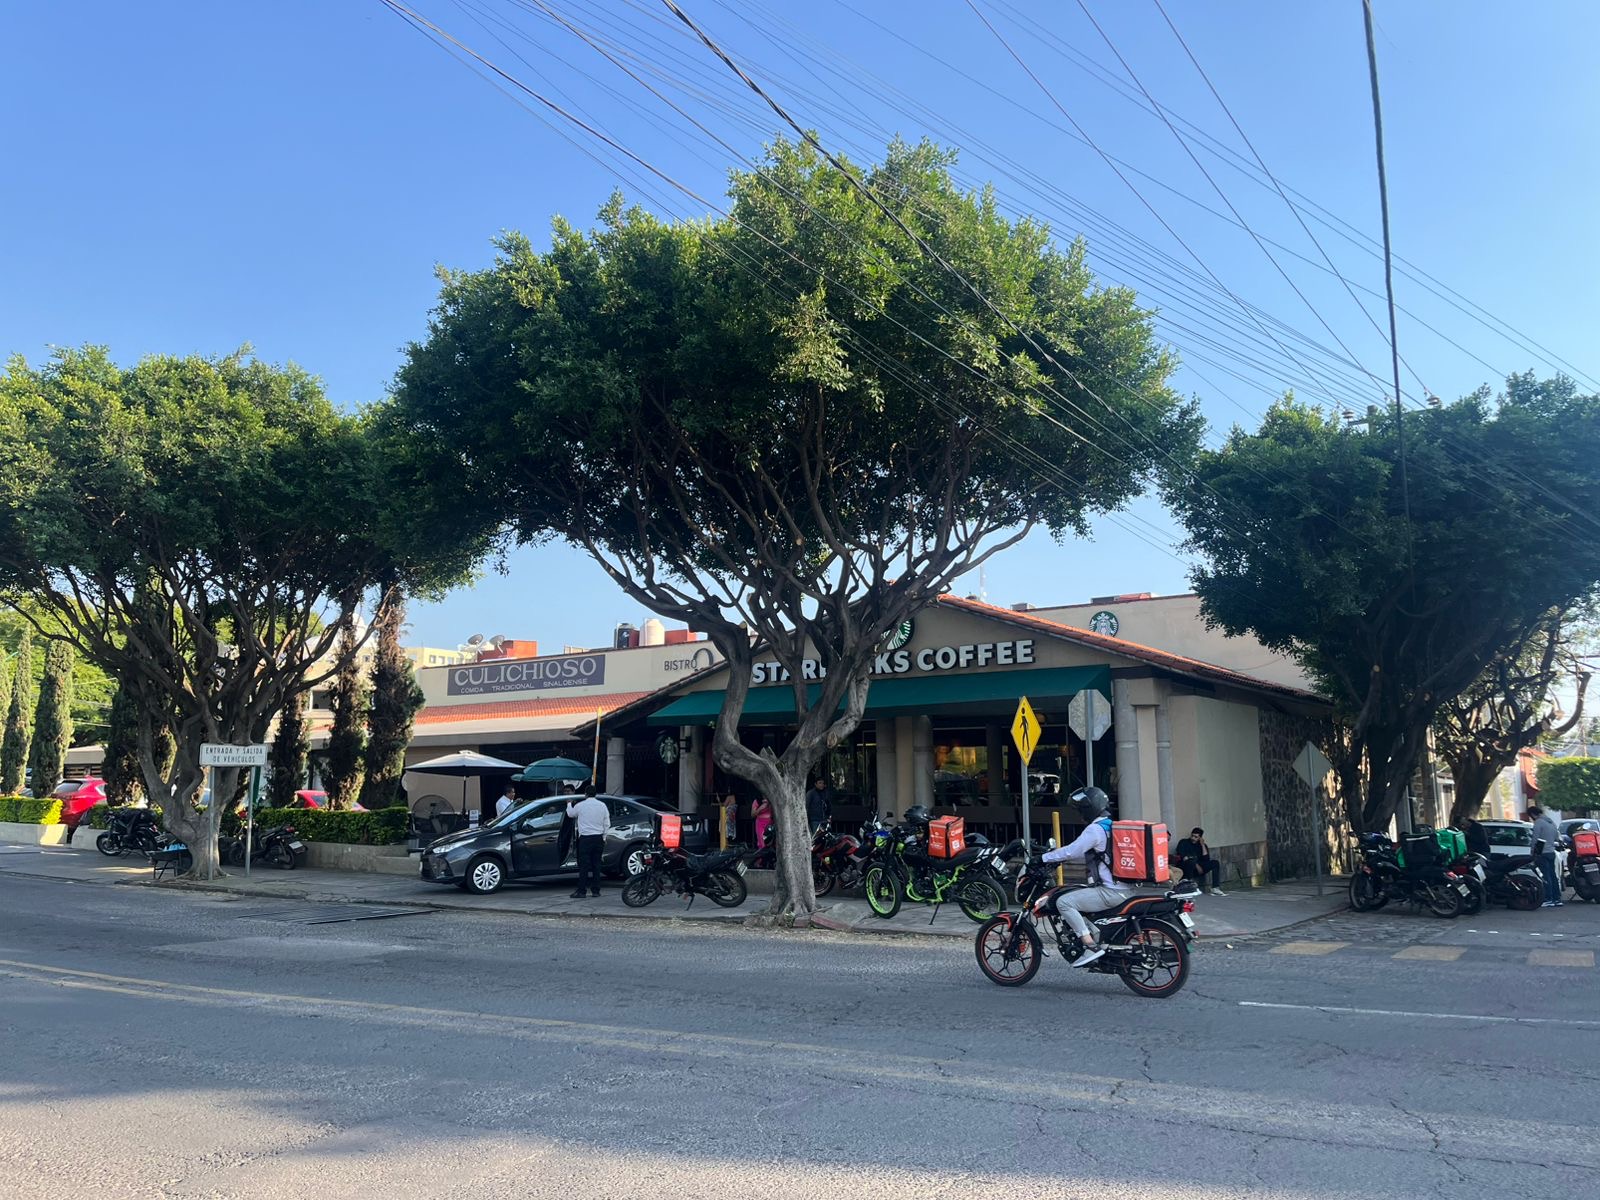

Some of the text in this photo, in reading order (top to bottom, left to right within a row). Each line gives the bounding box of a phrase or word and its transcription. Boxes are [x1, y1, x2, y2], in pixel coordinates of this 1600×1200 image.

[664, 658, 697, 671] BISTRO
[752, 640, 1033, 684] STARKS COFFEE
[454, 658, 596, 686] CULICHIOSO
[492, 683, 535, 691] TRADICIONAL
[543, 679, 588, 688] SINALOENSE
[1121, 857, 1136, 867] 6%
